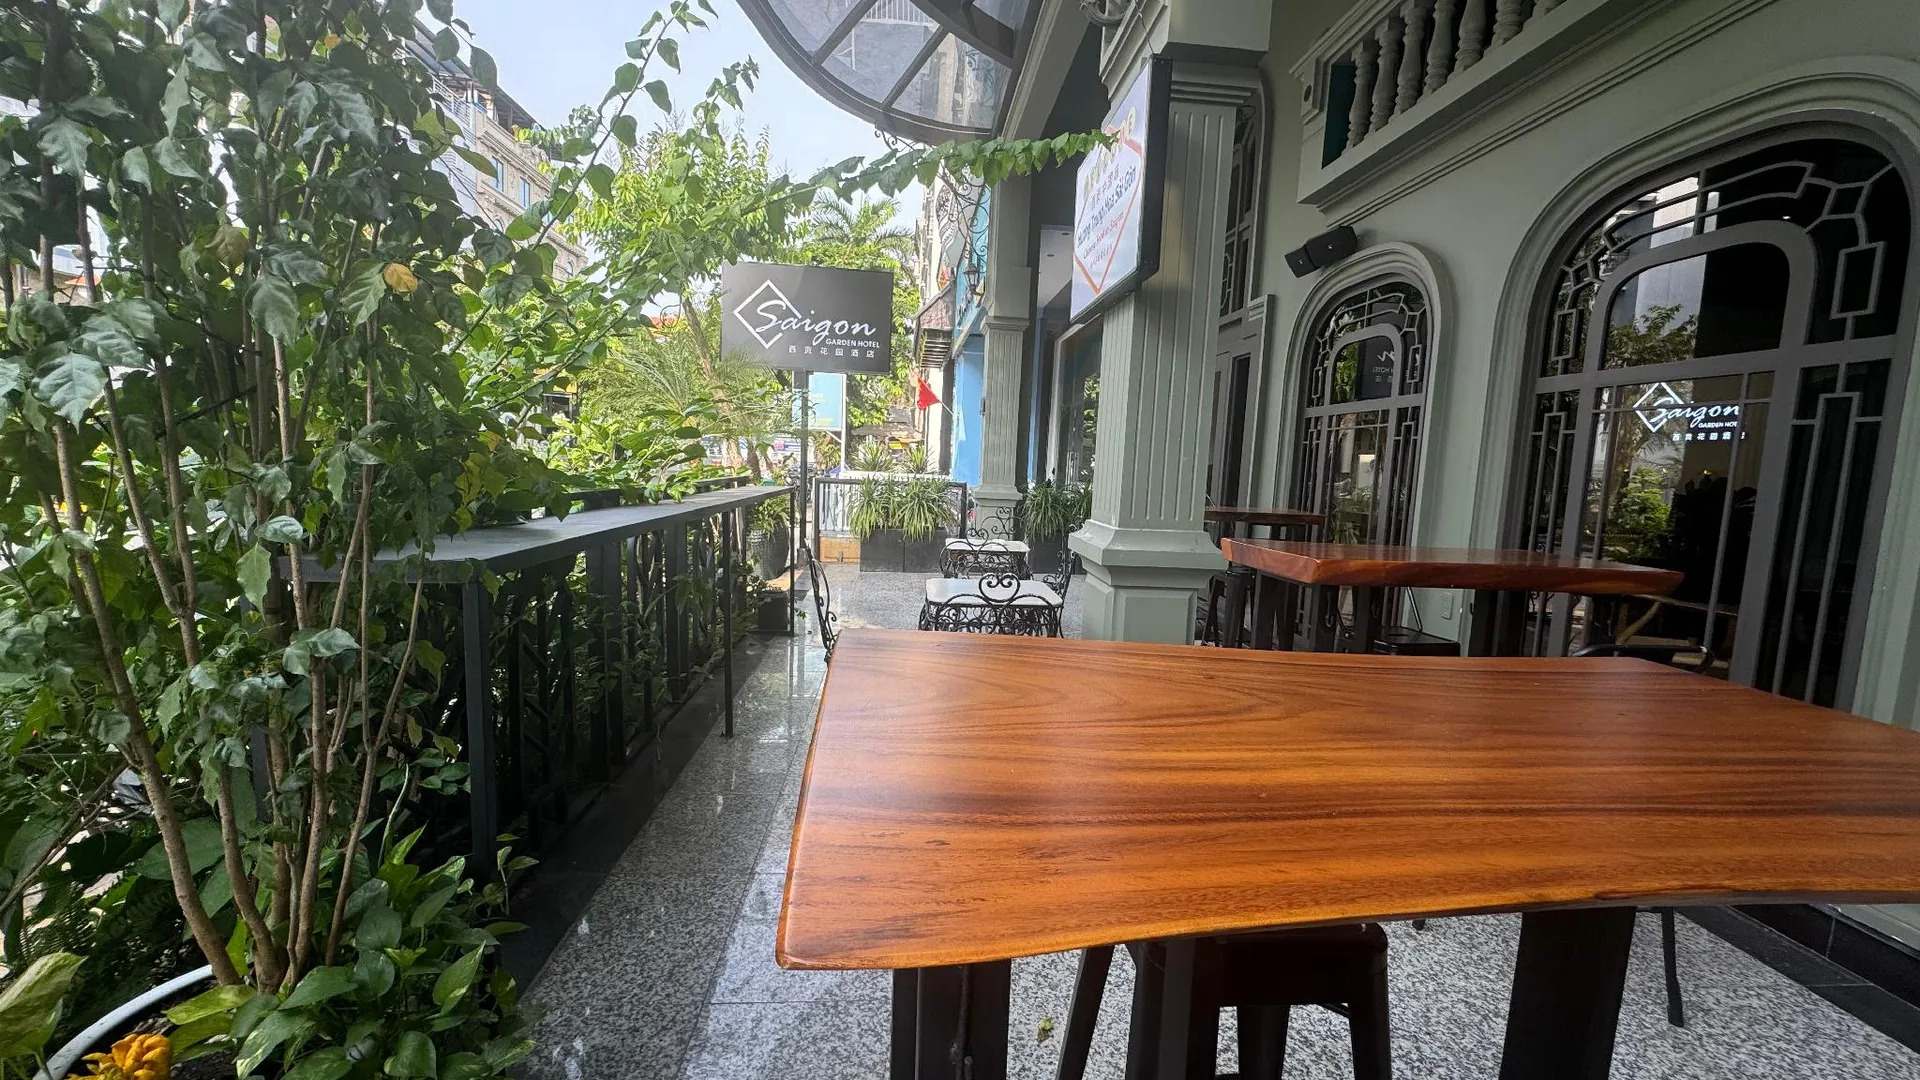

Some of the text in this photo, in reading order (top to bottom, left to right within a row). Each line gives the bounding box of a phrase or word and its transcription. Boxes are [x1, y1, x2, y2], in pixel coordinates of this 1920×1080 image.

[755, 299, 876, 346] Saigon
[788, 345, 875, 358] 西贡花园酒店
[825, 338, 880, 348] GARDEN HOTEL
[1649, 397, 1739, 428] Saigon
